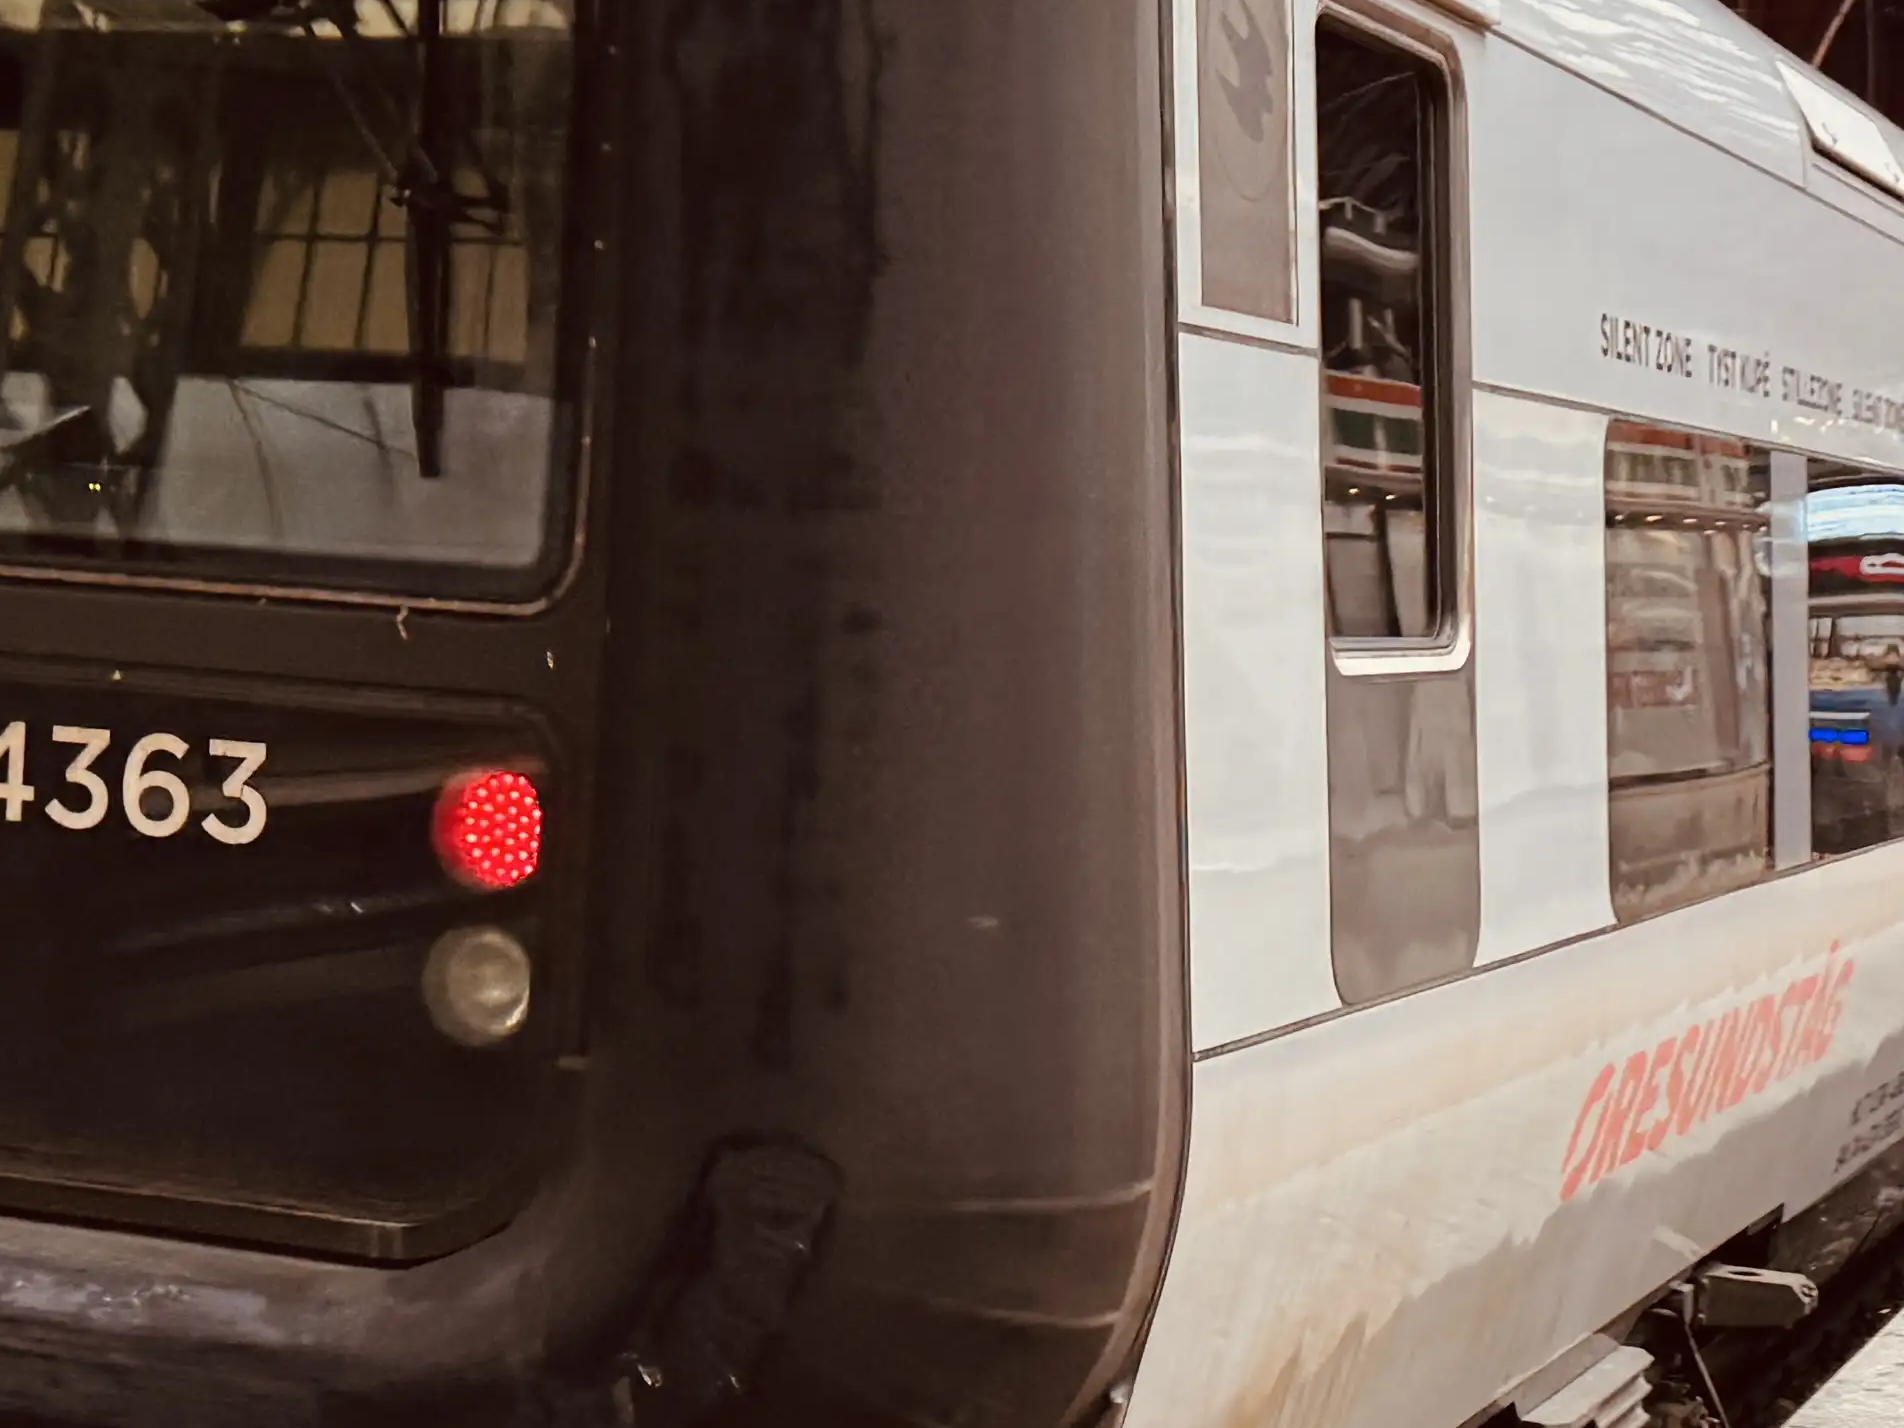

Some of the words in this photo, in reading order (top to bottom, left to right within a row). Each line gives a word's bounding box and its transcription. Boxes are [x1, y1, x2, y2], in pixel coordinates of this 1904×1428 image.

[1600, 312, 1651, 367] SILENT
[1656, 328, 1693, 378] ZONE
[1707, 343, 1737, 389] TYST
